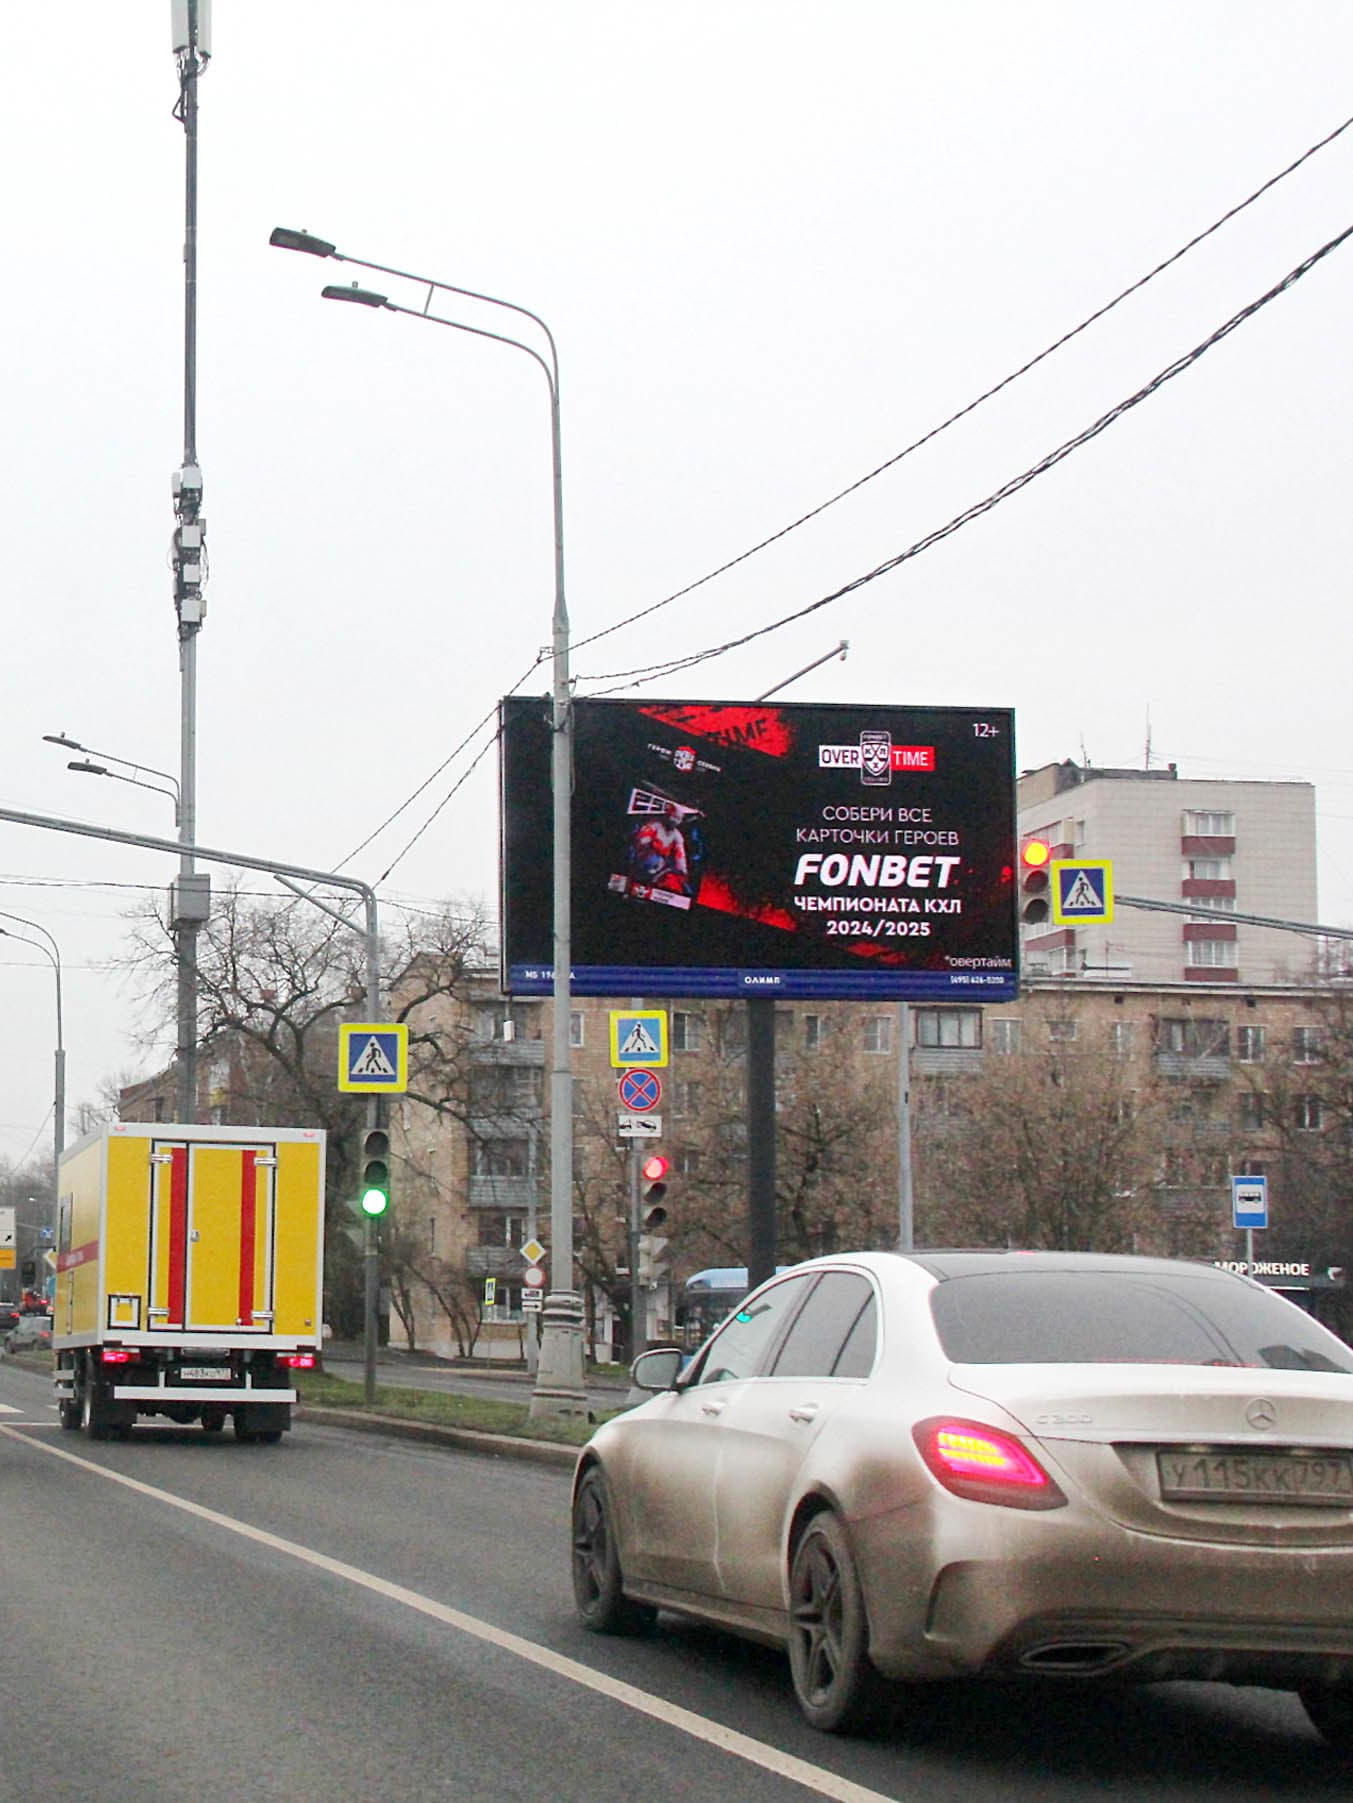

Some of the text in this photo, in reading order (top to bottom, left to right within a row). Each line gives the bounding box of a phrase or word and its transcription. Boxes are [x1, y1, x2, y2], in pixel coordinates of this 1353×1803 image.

[973, 723, 1000, 738] 12+
[821, 748, 929, 767] OVER TIME
[822, 806, 933, 823] СОБЕРИ ВСЕ
[796, 828, 960, 846] КАРТОЧКИ ГЕРОЕВ
[794, 853, 961, 889] FONBET
[794, 896, 962, 914] ЧЕМПИОНАТА КХЛ
[826, 919, 932, 938] 2024/2025
[744, 976, 780, 985] ОЛИМП
